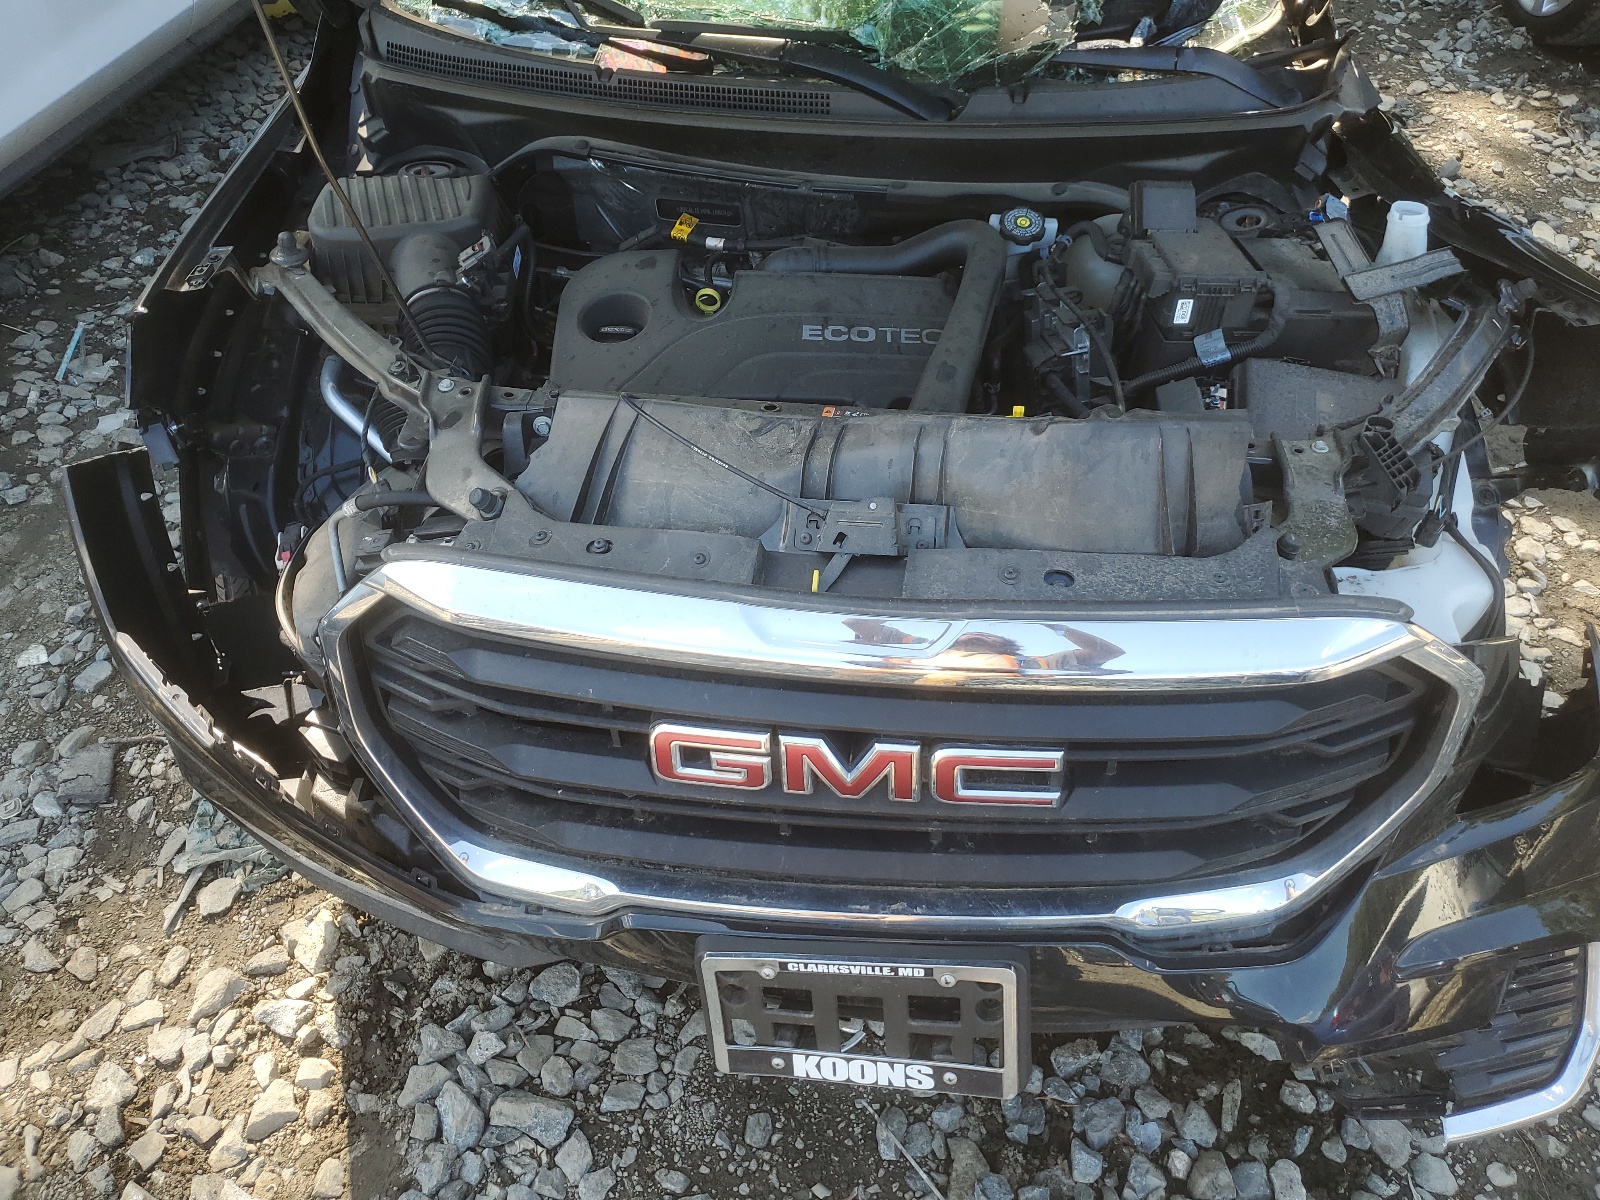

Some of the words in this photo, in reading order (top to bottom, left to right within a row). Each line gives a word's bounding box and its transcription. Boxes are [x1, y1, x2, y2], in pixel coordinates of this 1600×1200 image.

[802, 324, 943, 345] ECOTEC
[649, 723, 1065, 808] GMC
[898, 967, 925, 977] MD
[792, 1053, 935, 1090] KOONS
